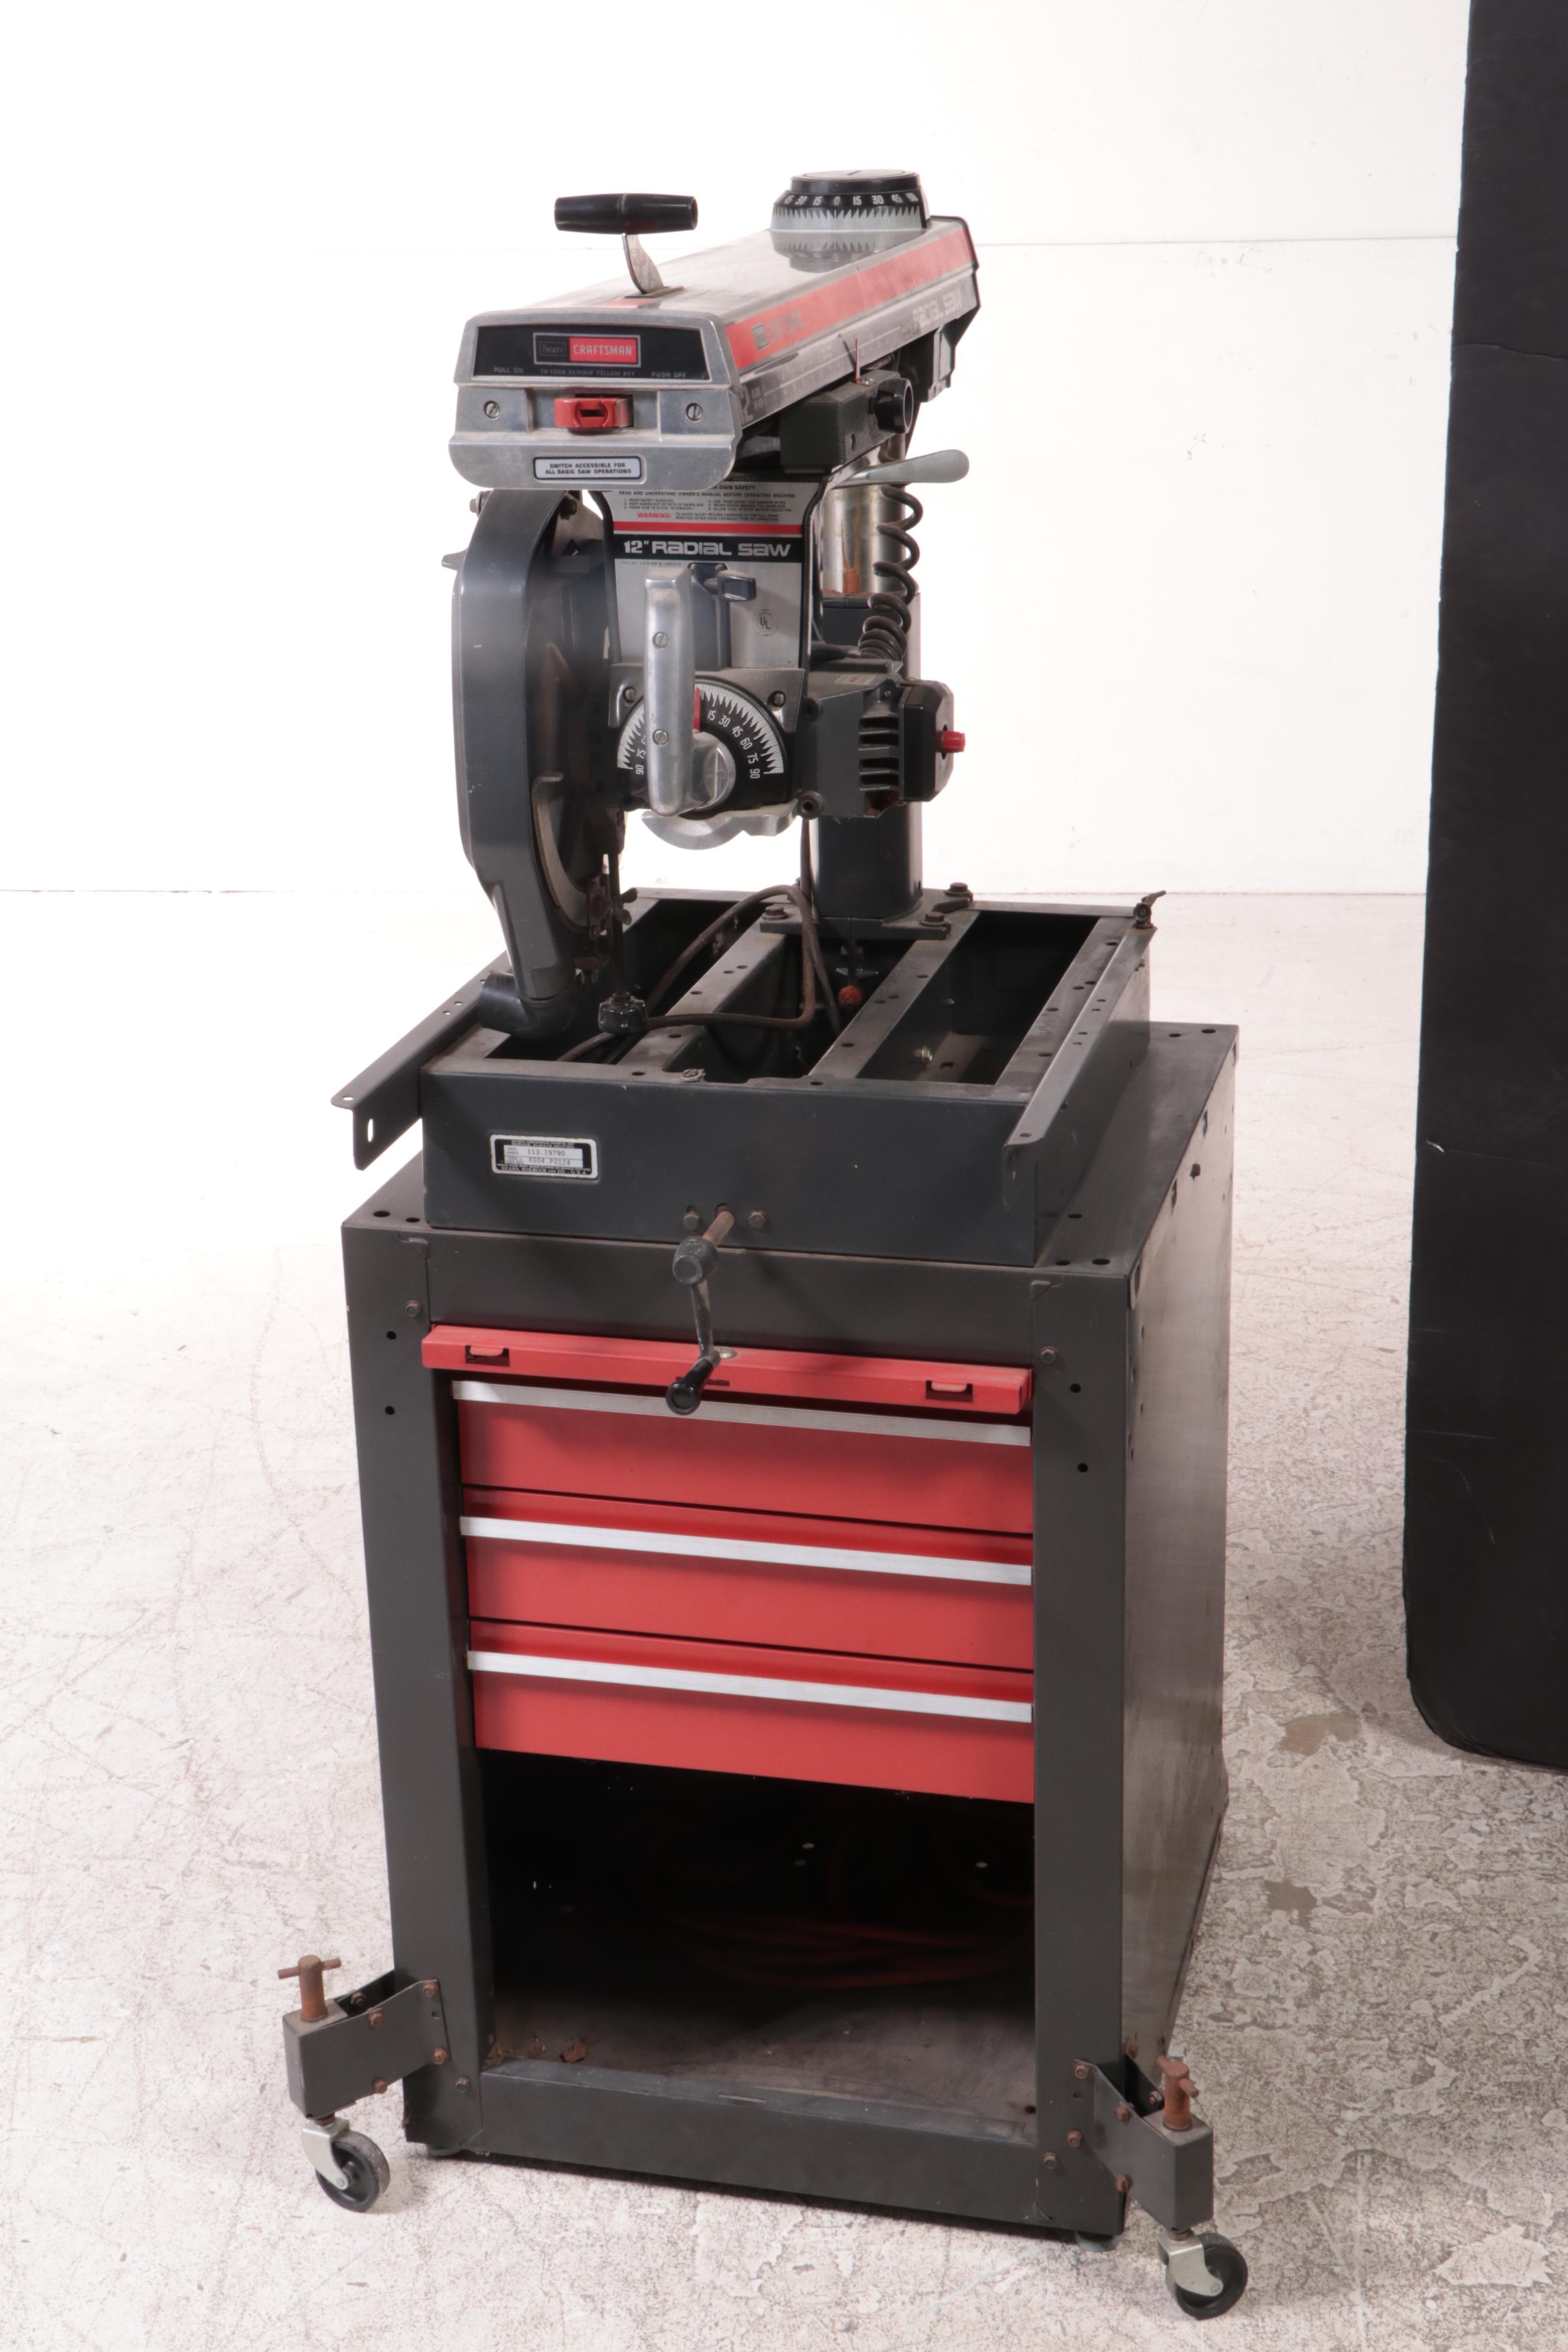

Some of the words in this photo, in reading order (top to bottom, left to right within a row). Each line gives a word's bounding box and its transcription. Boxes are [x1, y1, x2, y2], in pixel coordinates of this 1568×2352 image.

[813, 196, 823, 205] 15
[834, 196, 841, 205] 0
[853, 196, 861, 205] 15
[872, 195, 884, 205] 30
[891, 194, 903, 203] 45
[541, 344, 564, 354] Sears
[574, 344, 632, 355] CRAFTSMAN
[624, 540, 649, 553] 12"
[708, 710, 716, 721] 15
[718, 715, 731, 727] 30
[732, 726, 743, 737] 45
[740, 737, 753, 750] 60
[636, 748, 646, 759] 75
[747, 753, 759, 763] 75
[635, 764, 644, 775] 90
[750, 769, 760, 779] 90
